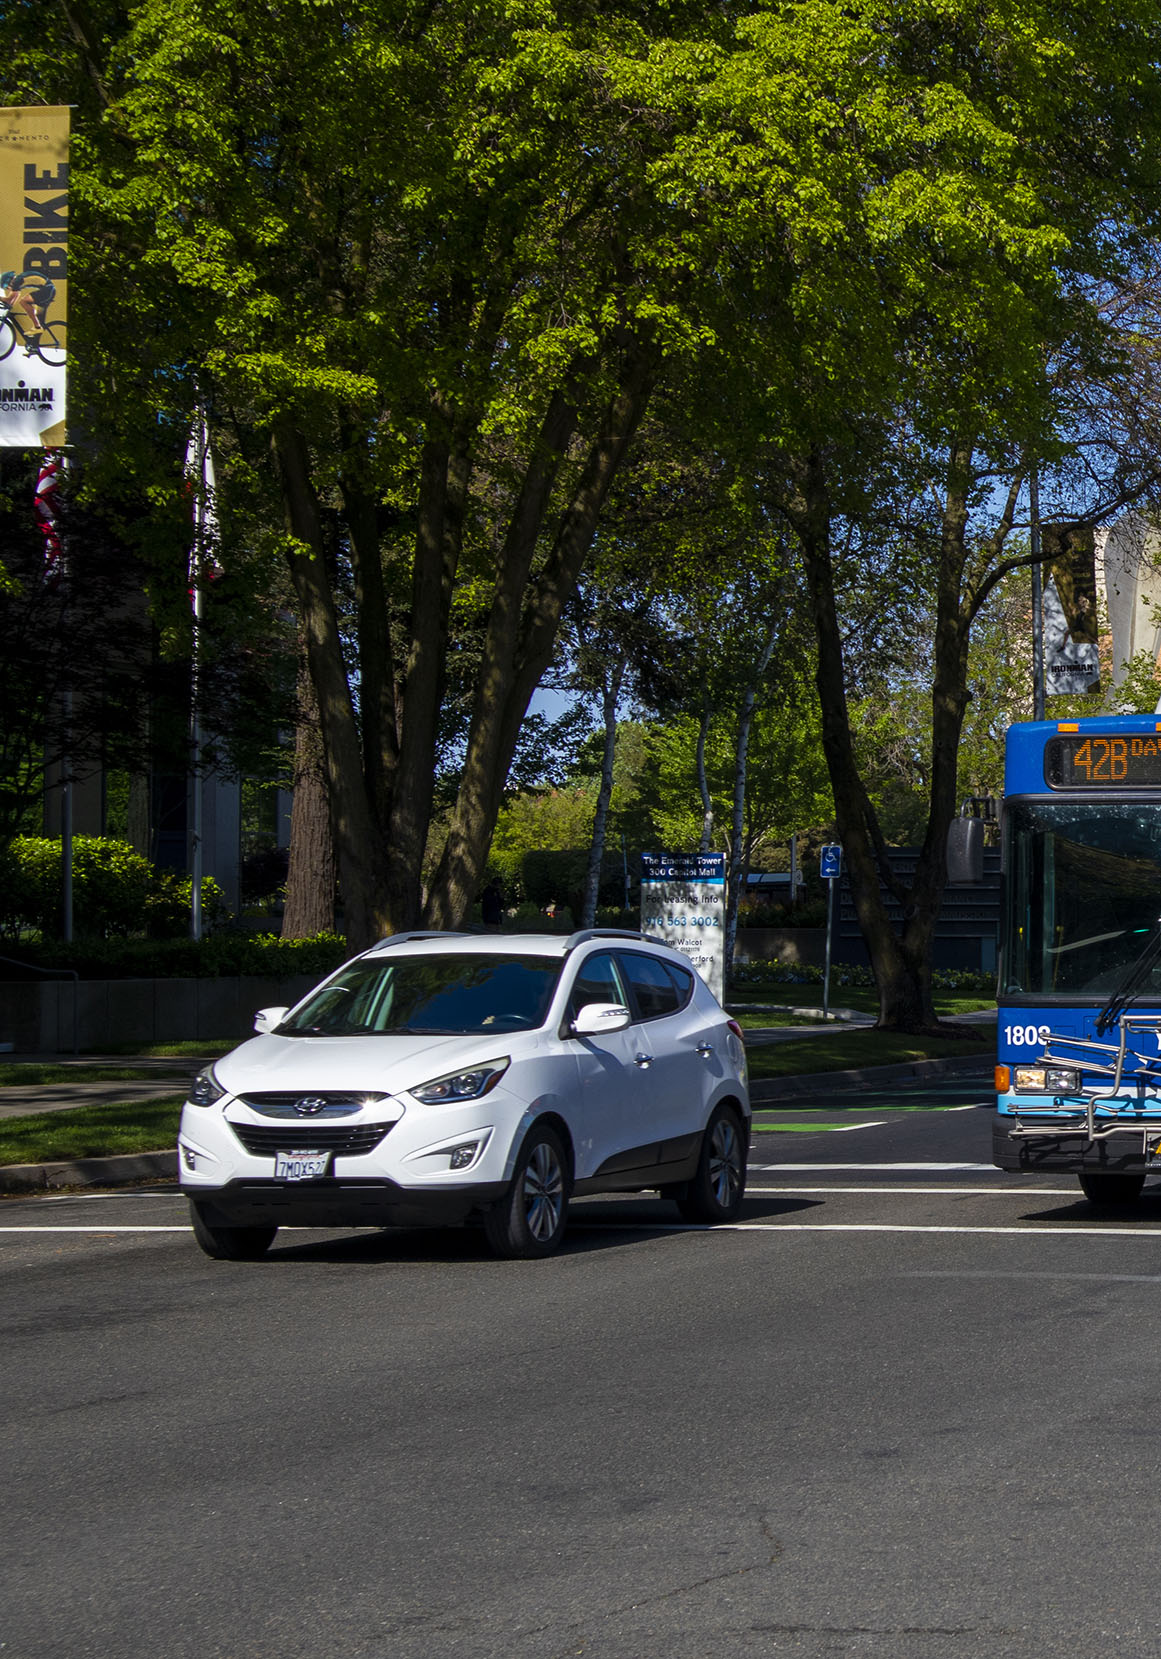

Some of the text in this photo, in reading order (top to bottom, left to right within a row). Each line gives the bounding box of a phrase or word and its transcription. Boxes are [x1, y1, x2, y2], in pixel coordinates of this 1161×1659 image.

[22, 163, 69, 280] BIKE
[0, 384, 54, 402] NMAN
[1051, 662, 1093, 673] IRONMAN
[1074, 739, 1128, 780] 42B
[643, 856, 722, 865] The Emerald Tower
[649, 867, 716, 877] 300 Capitol Mall
[646, 894, 719, 905] For Leasing Info
[646, 916, 719, 926] 916 563 3002
